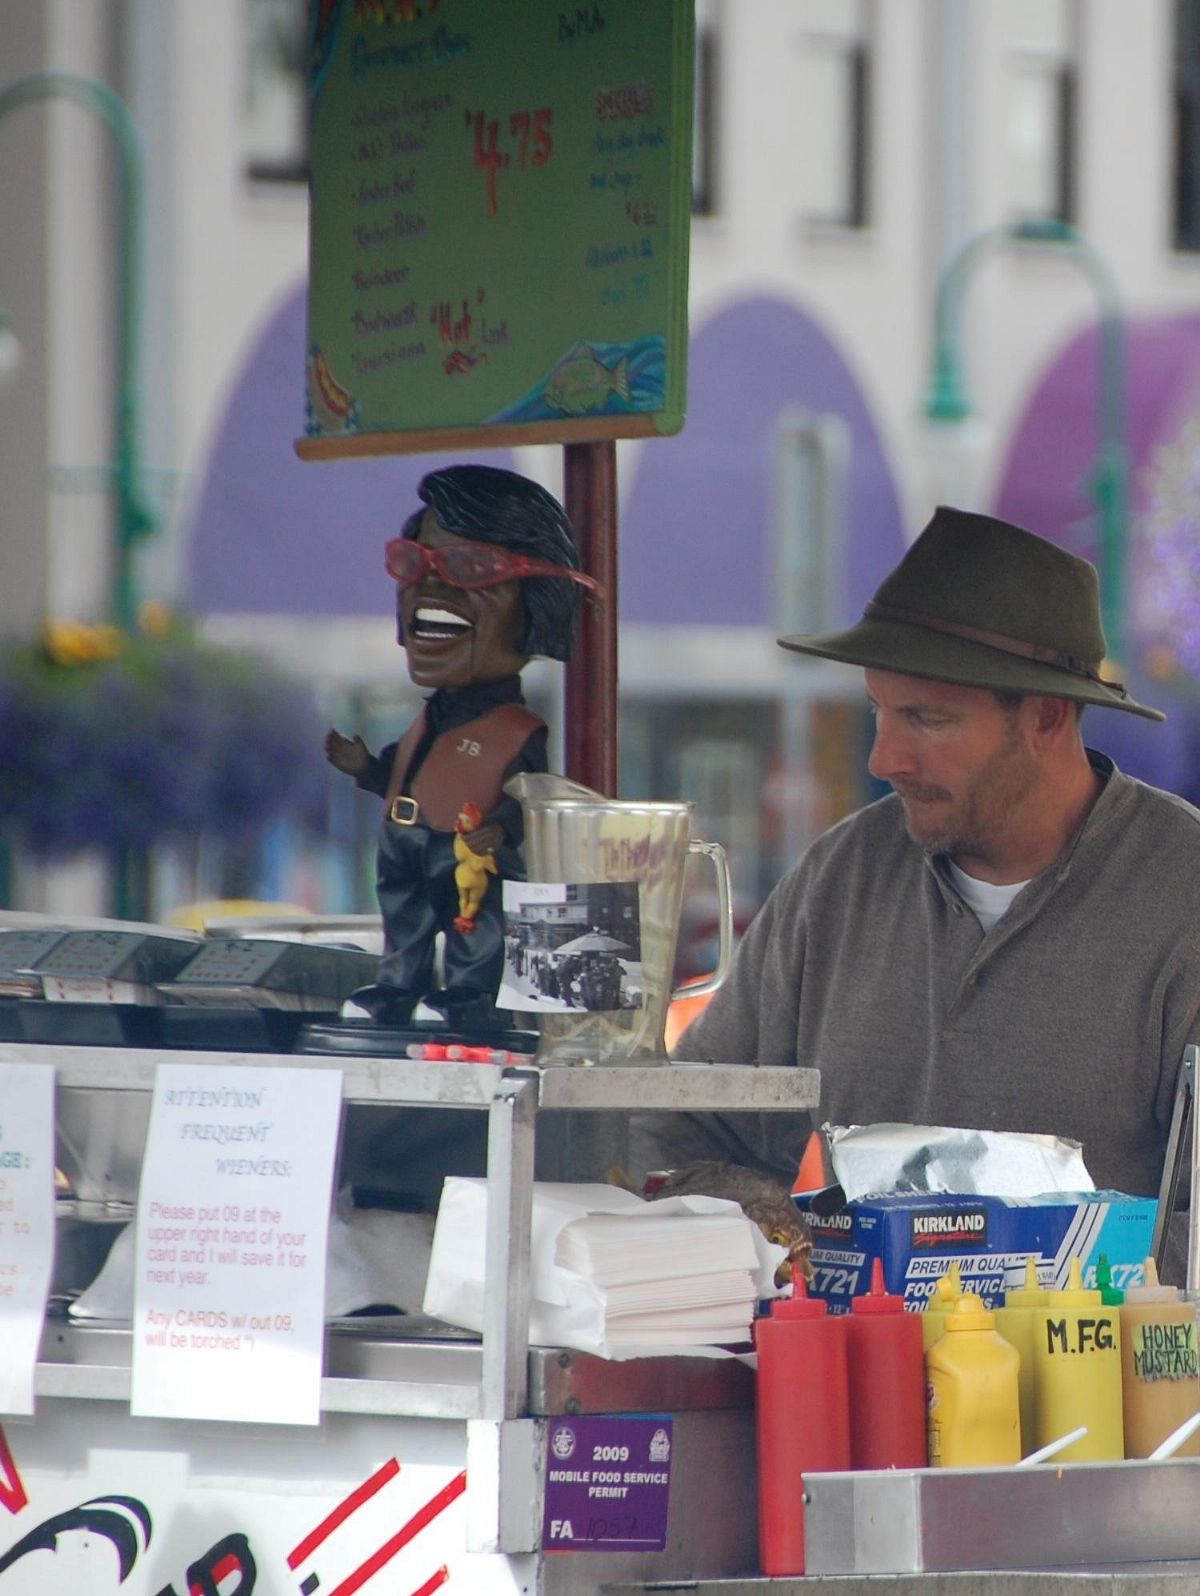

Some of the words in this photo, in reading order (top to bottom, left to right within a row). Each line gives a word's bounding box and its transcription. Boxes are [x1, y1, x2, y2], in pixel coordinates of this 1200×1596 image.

[164, 1087, 267, 1108] ATTENTION
[180, 1121, 274, 1144] FREQUENT
[149, 1202, 195, 1220] Please
[198, 1207, 220, 1224] put
[223, 1205, 240, 1222] 09
[243, 1208, 256, 1222] at
[260, 1207, 282, 1224] the
[802, 1212, 853, 1230] RKLAND
[913, 1215, 985, 1234] KIRKLAND
[149, 1227, 186, 1244] upper
[190, 1227, 219, 1246] right
[223, 1227, 256, 1244] hand
[260, 1228, 274, 1244] of
[277, 1233, 307, 1249] your
[148, 1248, 177, 1262] card
[180, 1248, 206, 1263] and
[217, 1249, 238, 1264] will
[241, 1253, 273, 1266] save
[277, 1251, 285, 1266] it
[288, 1252, 307, 1267] for
[825, 1252, 861, 1264] QUALITY
[911, 1258, 974, 1274] PREMM
[147, 1269, 175, 1283] next
[146, 1309, 174, 1330] Any
[175, 1308, 228, 1328] CARDS
[250, 1314, 271, 1330] out
[144, 1331, 167, 1347] will
[170, 1331, 187, 1348] be
[191, 1334, 241, 1351] torched
[1142, 1323, 1193, 1350] HONEY
[1133, 1349, 1198, 1377] MUSTARD
[592, 1446, 630, 1462] 2009
[549, 1471, 590, 1482] MOBILE
[592, 1471, 622, 1483] FOOD
[624, 1472, 669, 1484] SERVICE
[588, 1486, 629, 1499] PERMIT
[550, 1520, 574, 1539] FA
